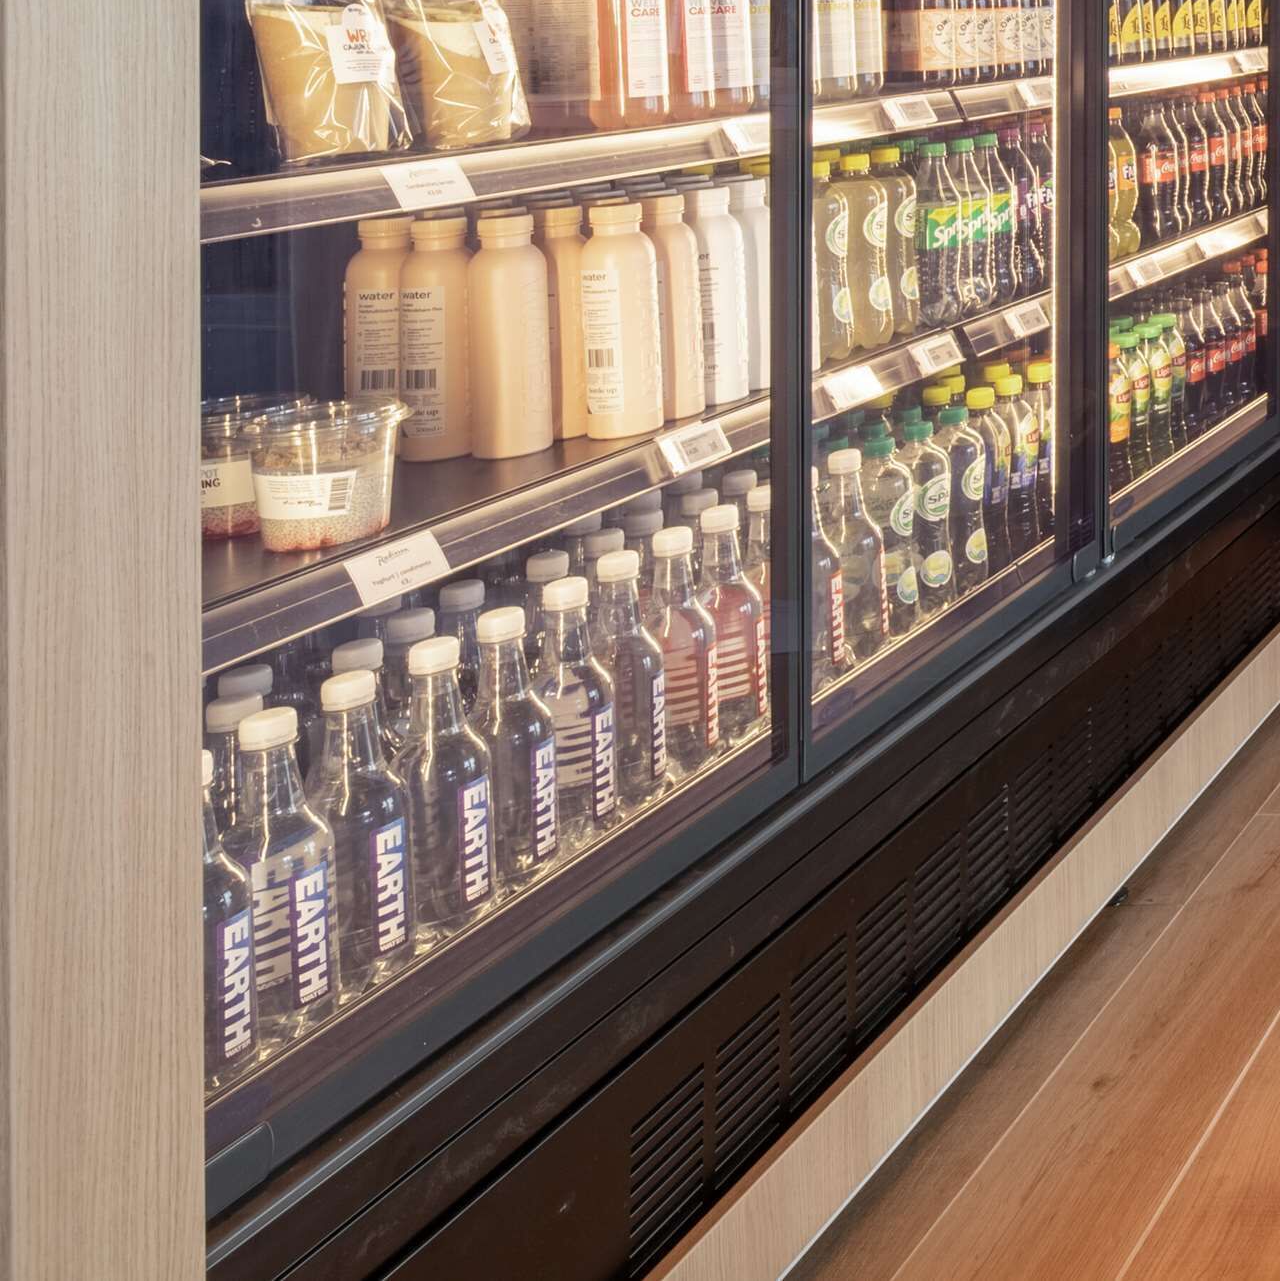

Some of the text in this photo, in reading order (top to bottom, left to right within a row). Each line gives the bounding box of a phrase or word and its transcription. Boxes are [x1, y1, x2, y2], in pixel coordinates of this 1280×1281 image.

[631, 8, 660, 17] CARE
[359, 291, 395, 301] water
[401, 290, 431, 300] water
[595, 710, 614, 815] EARTH
[376, 825, 405, 946] EARTH
[464, 781, 489, 897] EARTH
[223, 916, 251, 1053] EARTH
[295, 870, 328, 998] EARTH
